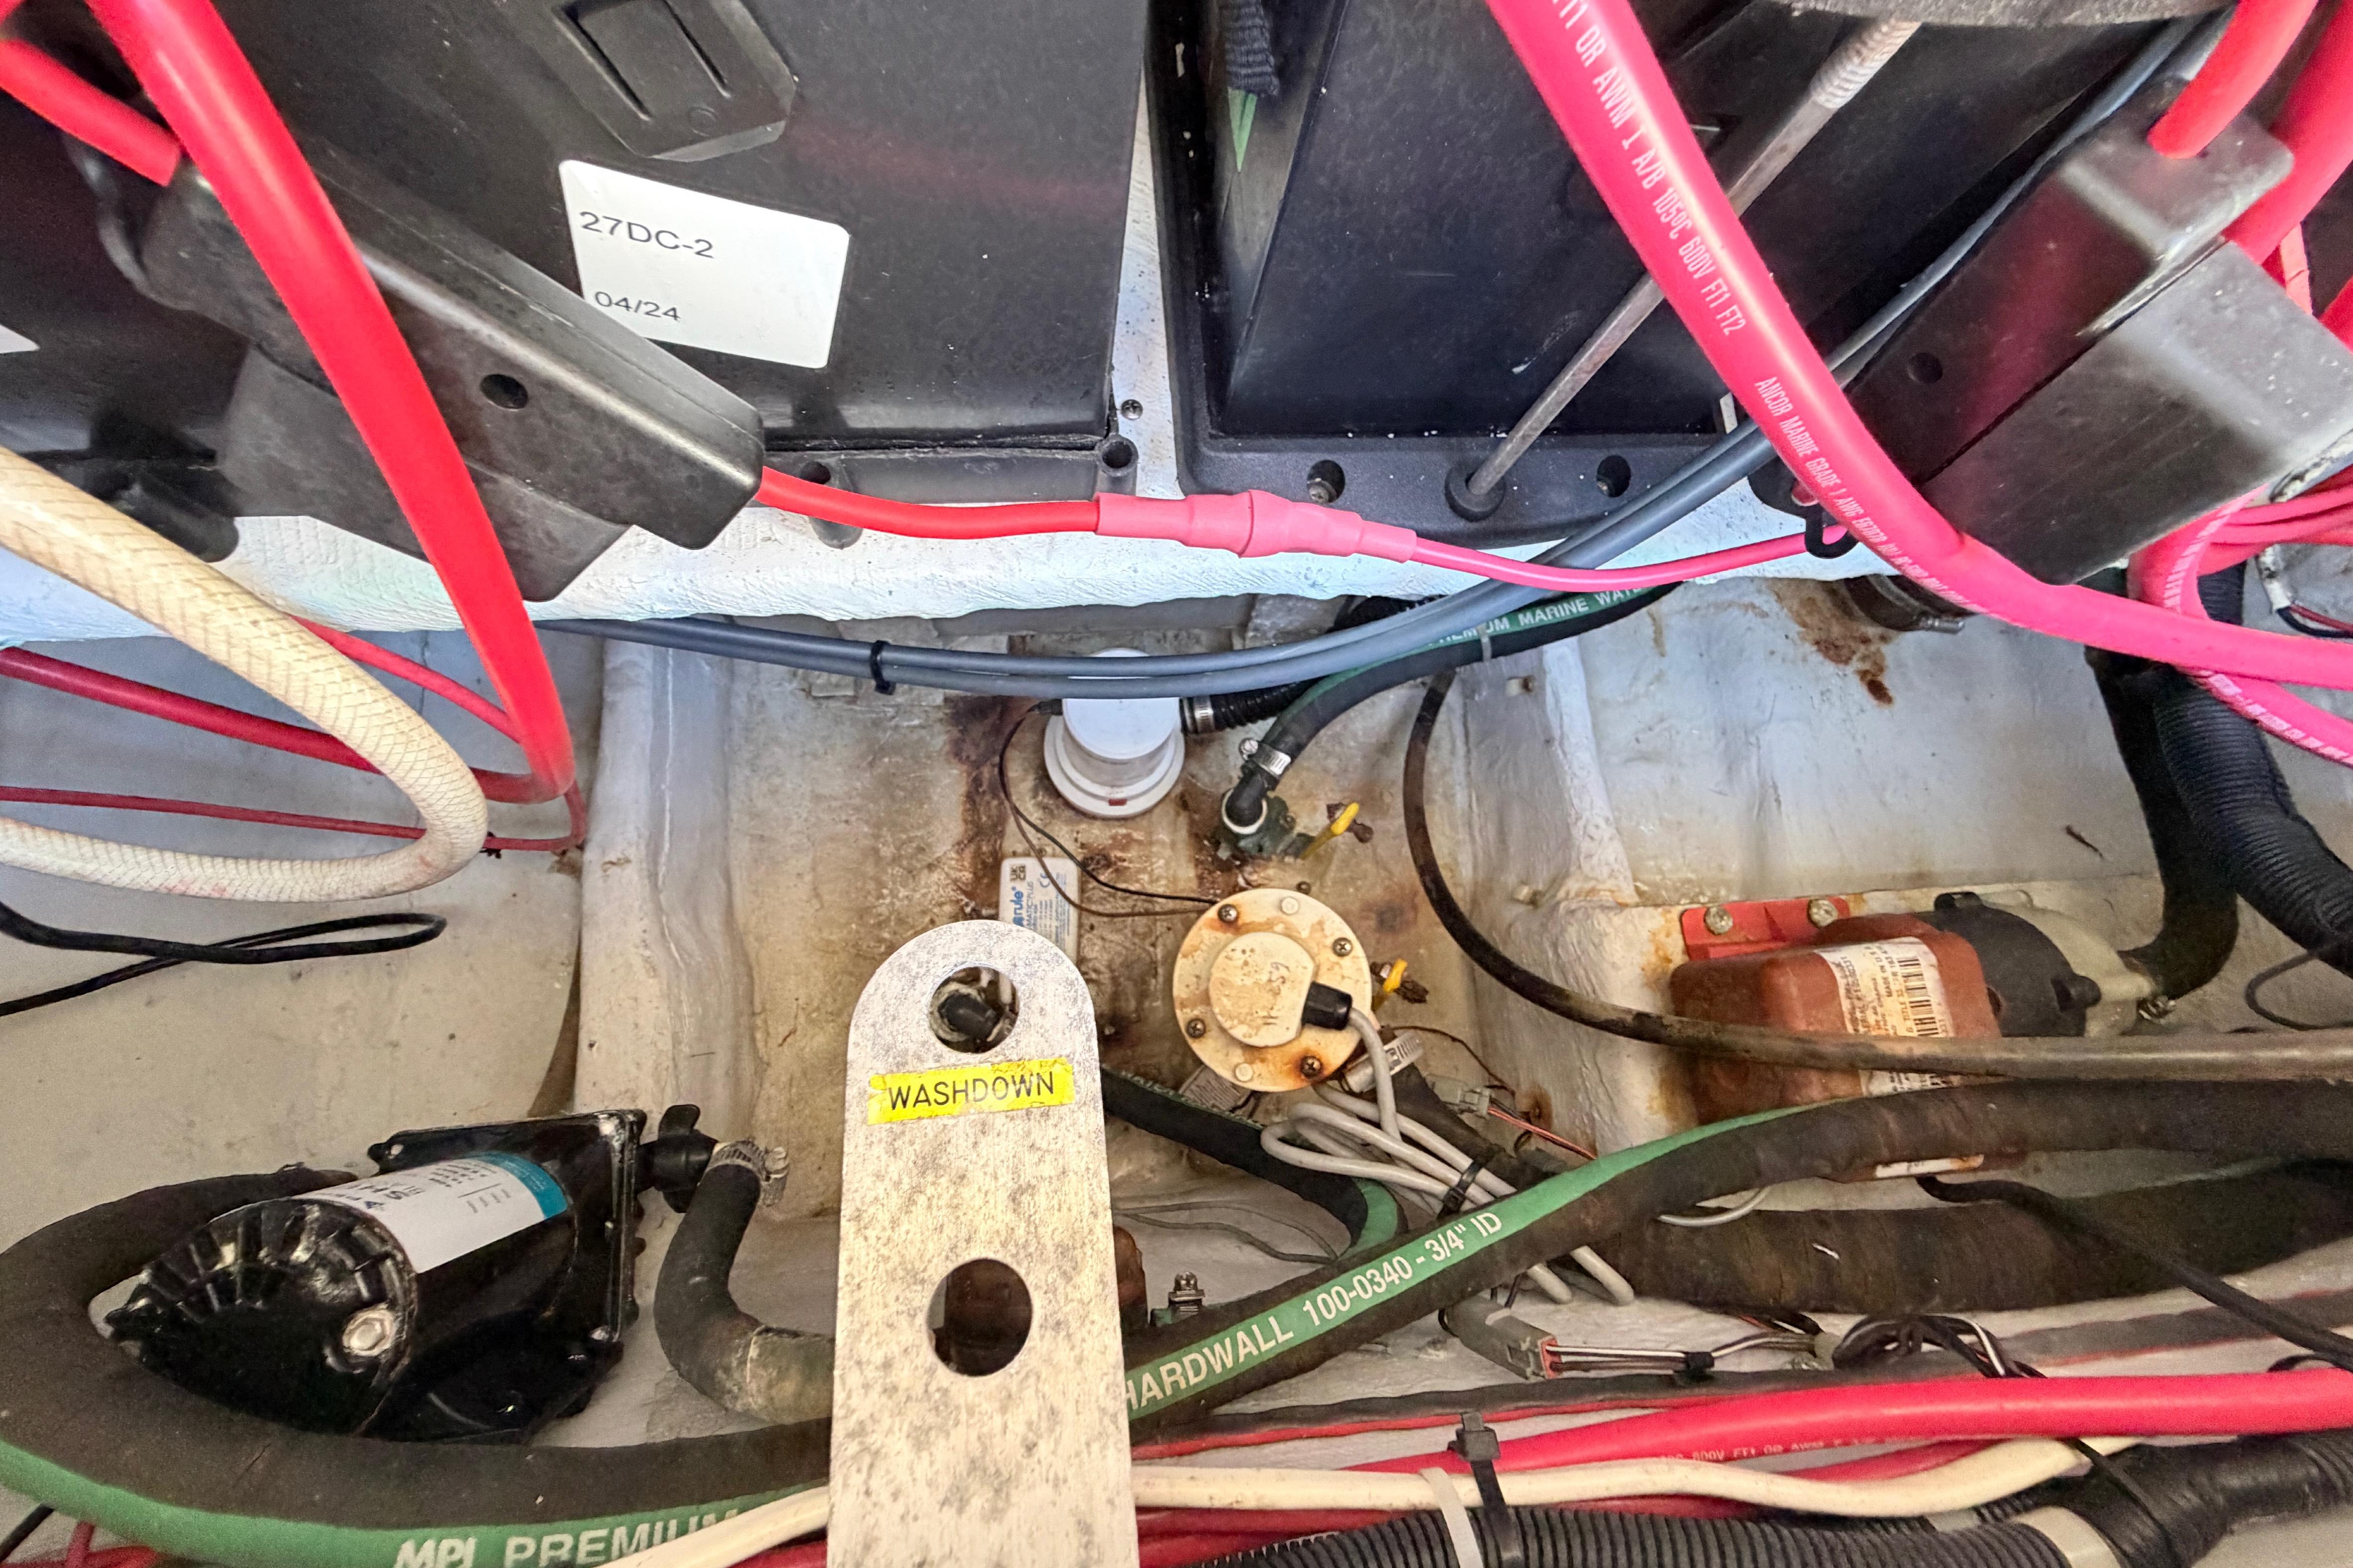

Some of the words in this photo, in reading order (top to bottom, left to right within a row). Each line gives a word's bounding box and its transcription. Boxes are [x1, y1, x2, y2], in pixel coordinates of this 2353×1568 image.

[1576, 25, 1606, 68] OR
[1593, 67, 1637, 129] AWM
[1632, 148, 1666, 189] A/B
[1678, 235, 1717, 279] 600V
[1701, 278, 1731, 308] FT1
[1716, 304, 1746, 336] FT2
[580, 211, 715, 259] 27DC-2
[595, 291, 681, 322] 04/24
[1754, 377, 1793, 417] ANCOR
[1779, 415, 1820, 458] MARINE
[1805, 457, 1842, 489] GRADE
[1833, 497, 1865, 517] AWG
[1518, 598, 1589, 626] MARINE
[888, 1071, 1055, 1111] WASHDOWN
[1302, 1255, 1413, 1327] 100-0340
[1425, 1224, 1466, 1262] 3/4"
[1474, 1211, 1503, 1238] ID
[396, 1537, 477, 1568] MPI
